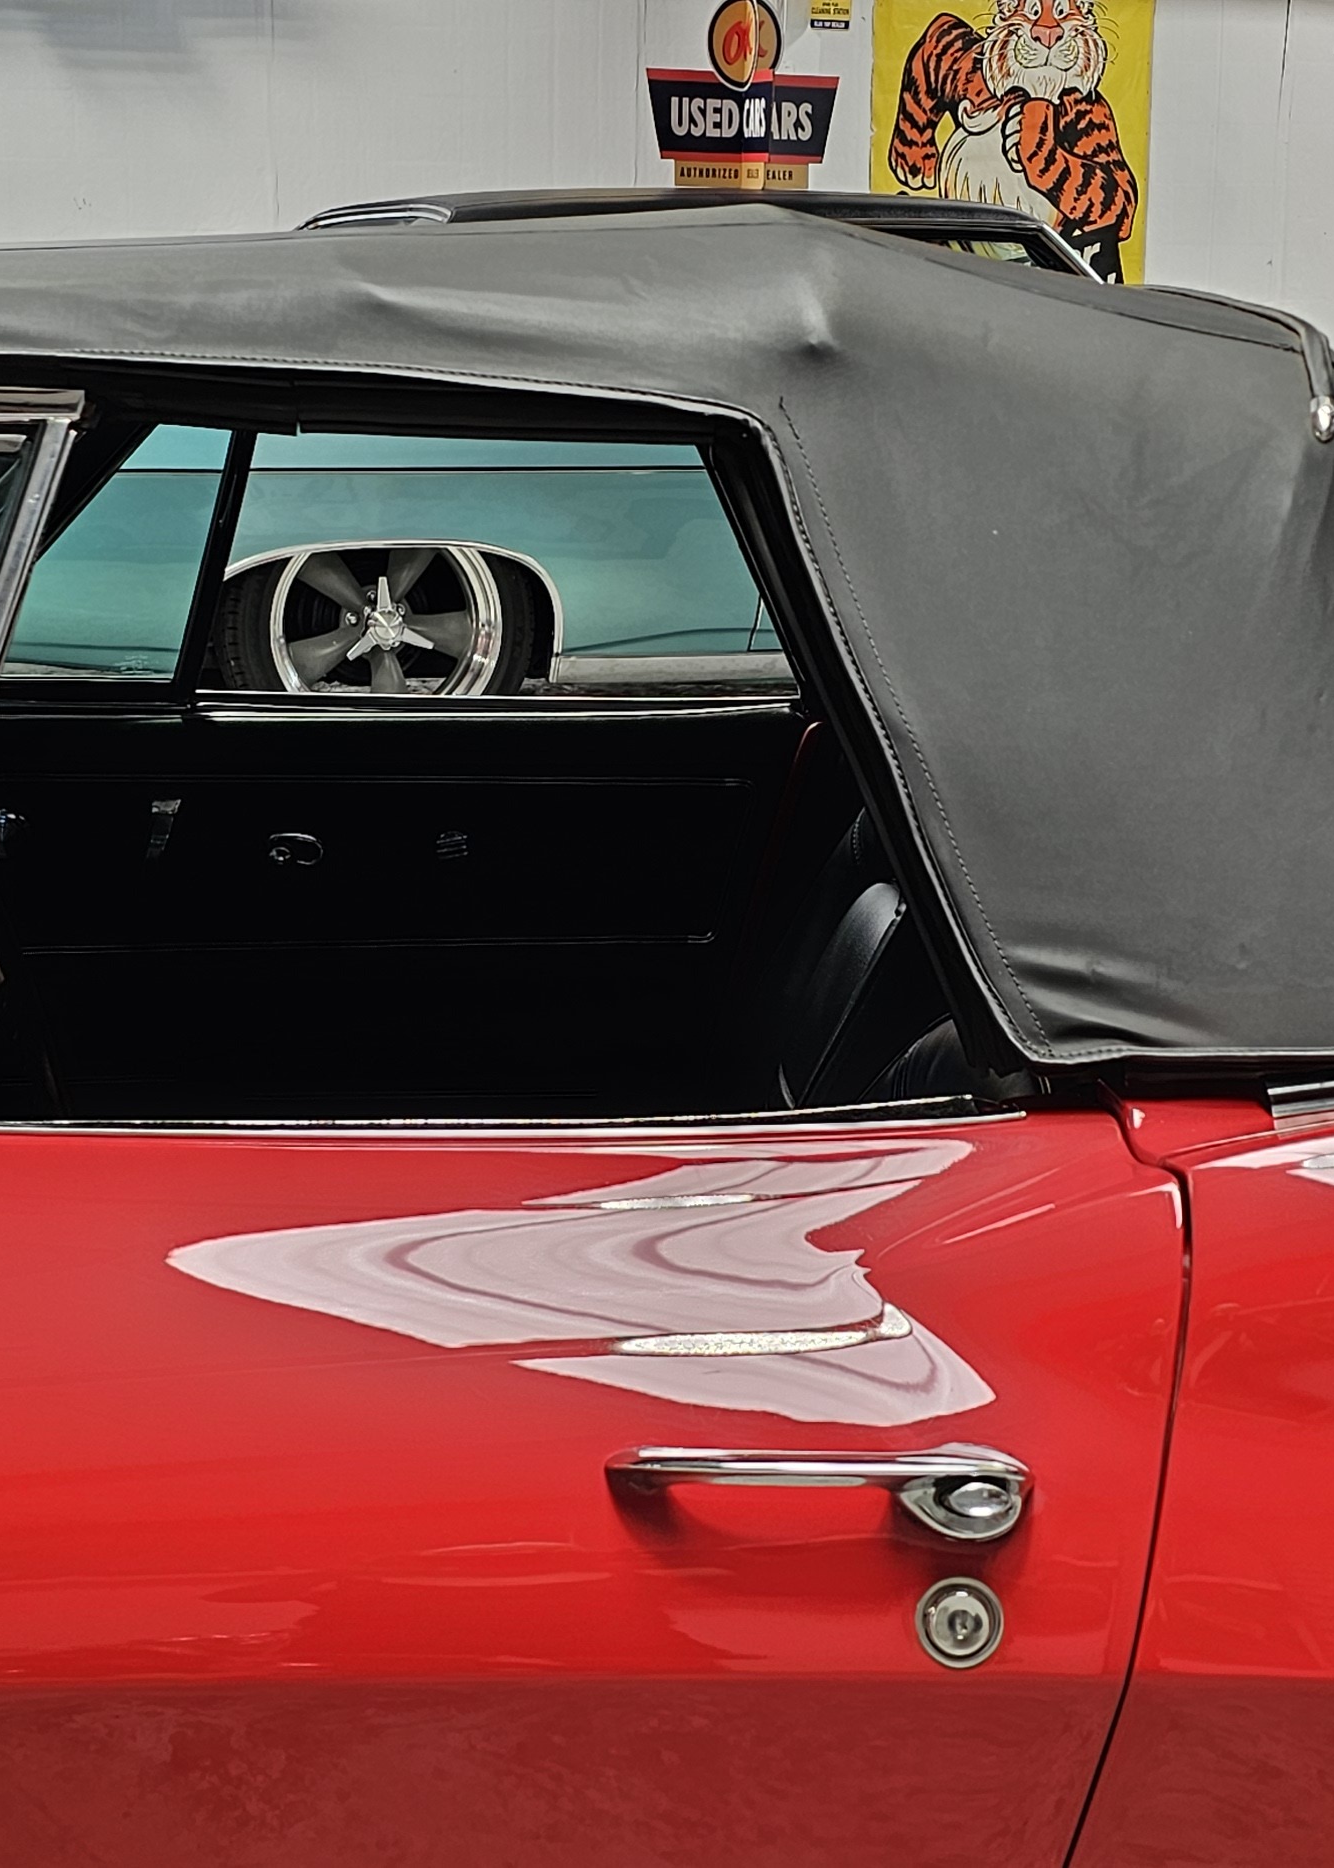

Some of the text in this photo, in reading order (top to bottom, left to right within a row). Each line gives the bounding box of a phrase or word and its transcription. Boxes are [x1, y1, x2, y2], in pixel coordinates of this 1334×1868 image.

[670, 96, 766, 138] USED CARS
[770, 102, 813, 141] ARS
[679, 166, 739, 179] AUTHORIZED
[766, 169, 794, 181] EALER
